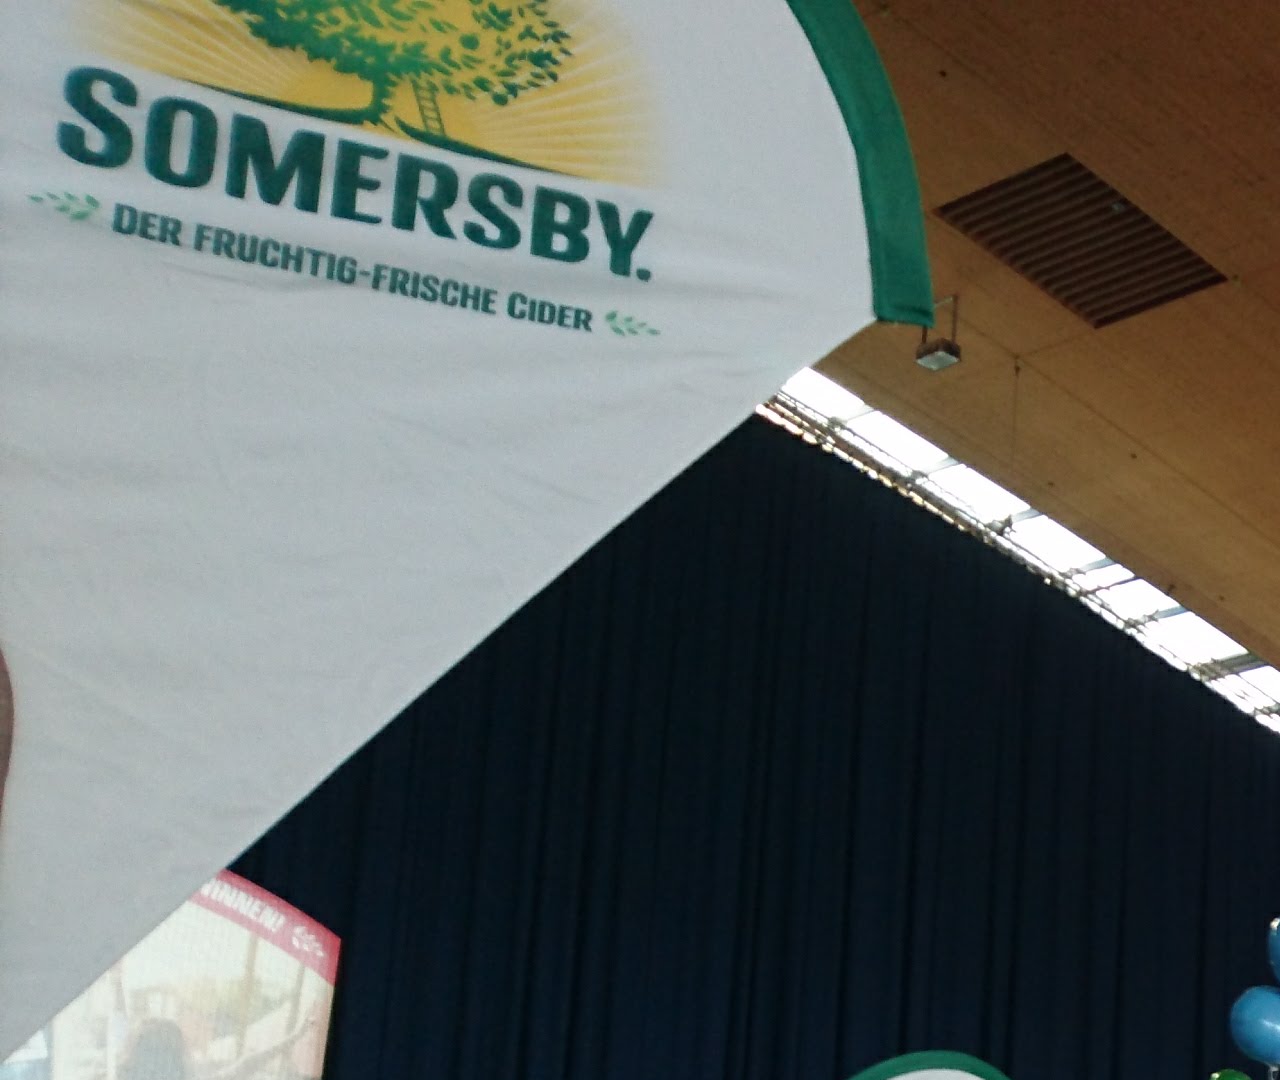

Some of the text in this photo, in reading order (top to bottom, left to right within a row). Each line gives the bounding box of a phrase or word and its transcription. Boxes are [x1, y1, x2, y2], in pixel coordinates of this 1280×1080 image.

[57, 65, 653, 283] SOMERSBY.
[112, 203, 593, 331] DER FRUCHTIG-FRISCHE CIDER
